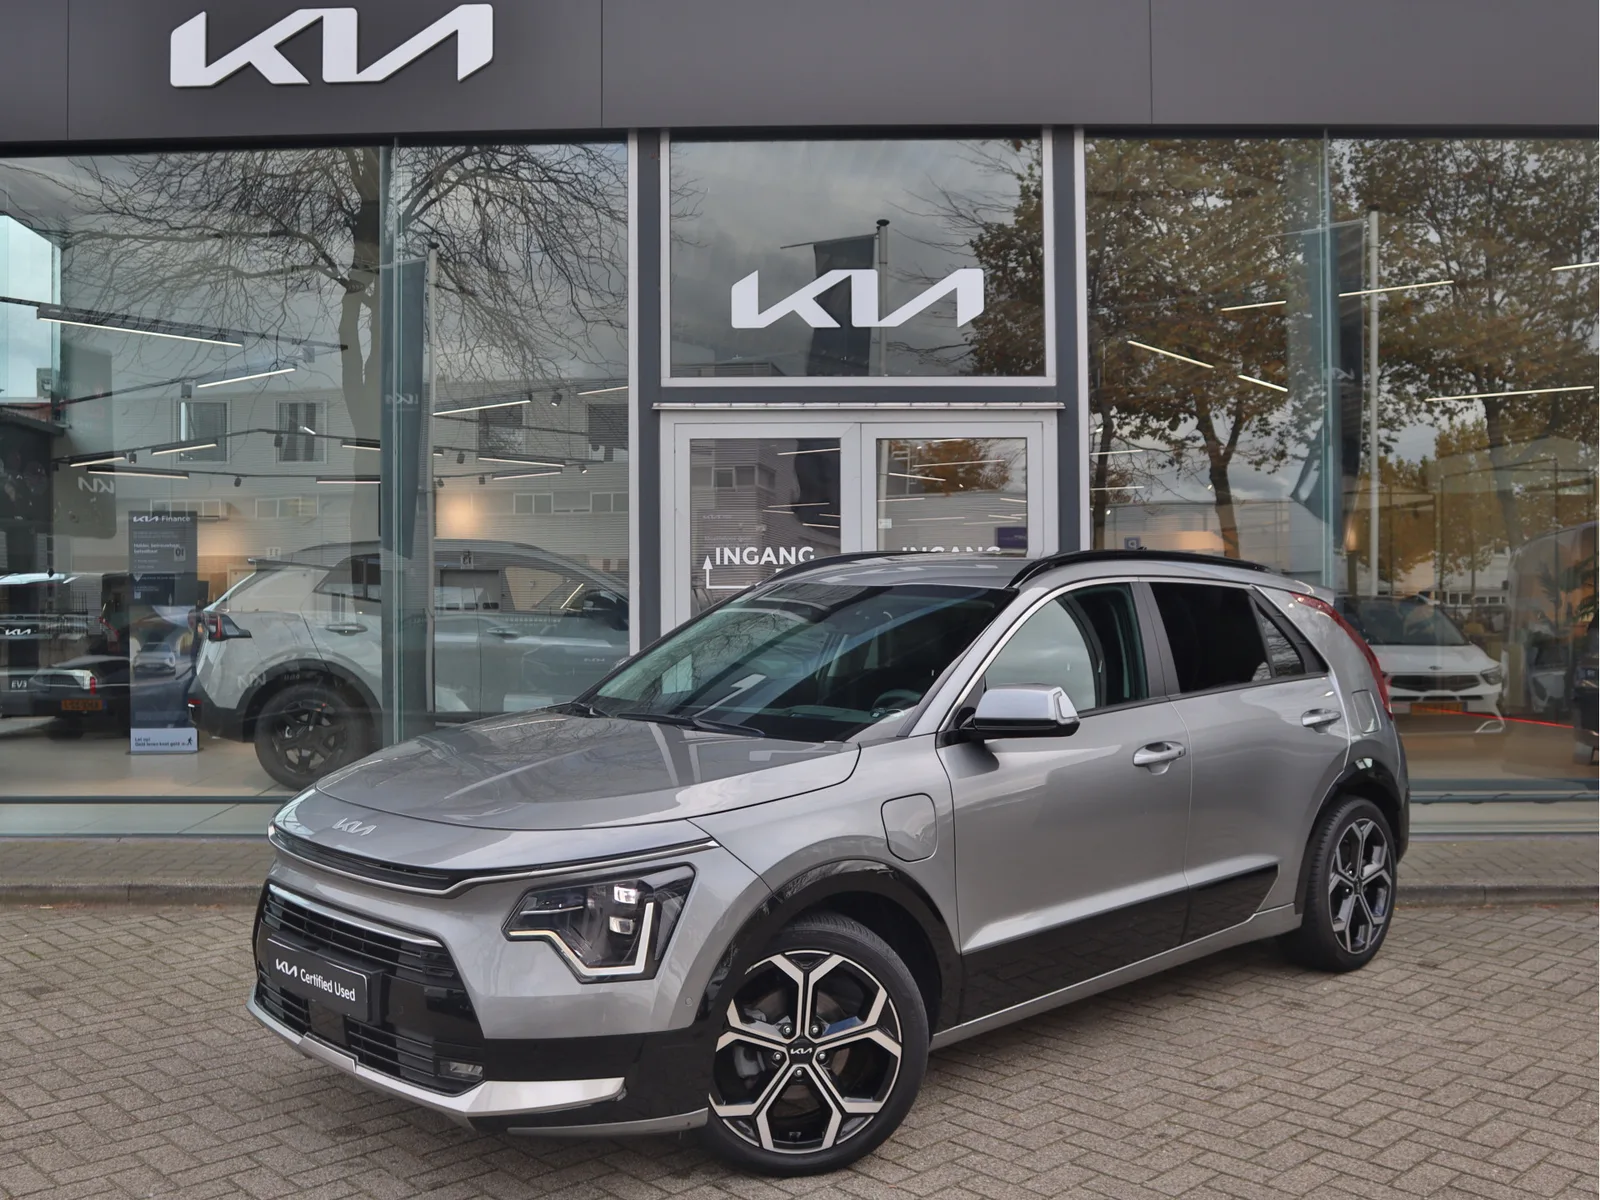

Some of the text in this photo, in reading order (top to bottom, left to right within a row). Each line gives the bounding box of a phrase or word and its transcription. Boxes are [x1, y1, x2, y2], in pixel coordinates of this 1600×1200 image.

[170, 3, 493, 87] KIA
[731, 268, 984, 328] KIA
[132, 515, 159, 523] KIA
[715, 546, 815, 565] INGANG
[5, 628, 31, 636] KIA
[11, 680, 27, 688] EV3
[332, 817, 377, 836] KIA
[276, 958, 356, 1001] KIA Certified Used
[790, 1047, 813, 1055] KIA
